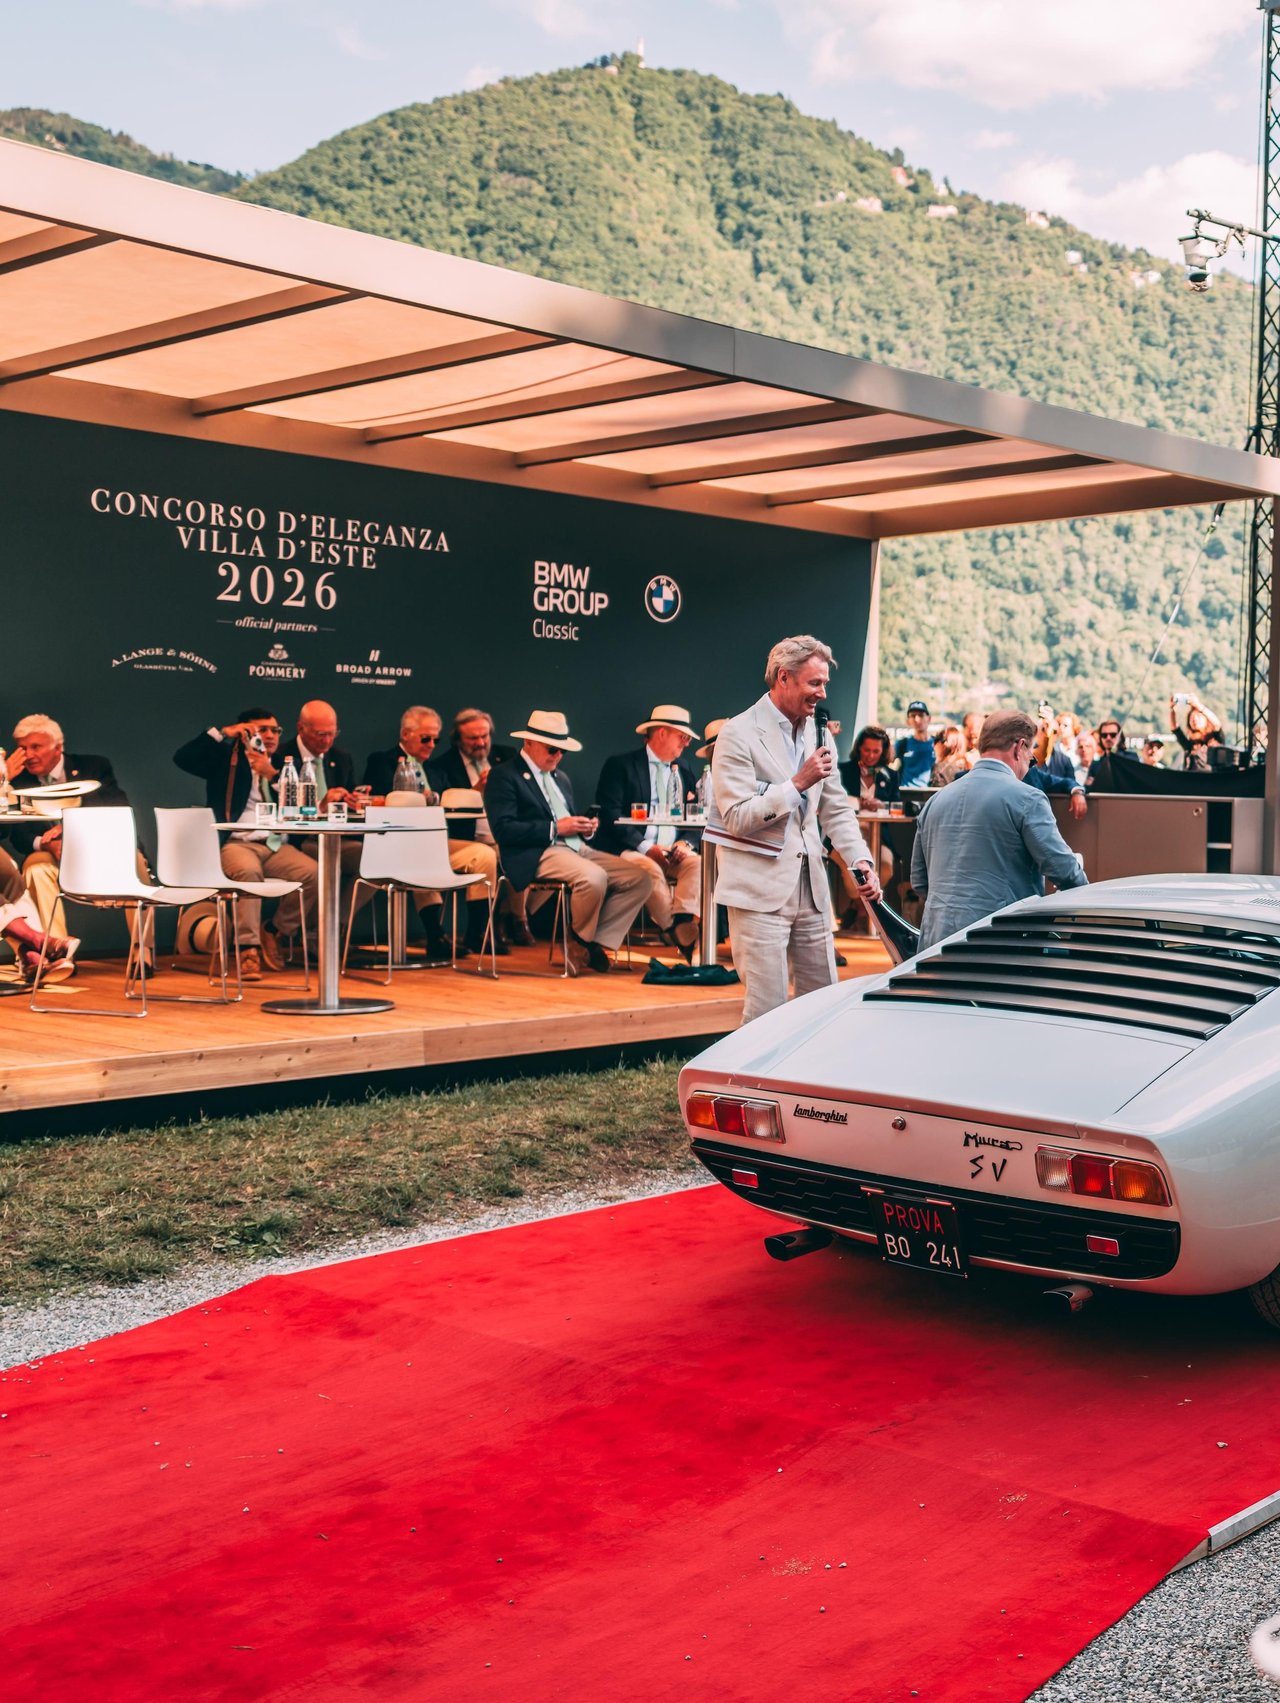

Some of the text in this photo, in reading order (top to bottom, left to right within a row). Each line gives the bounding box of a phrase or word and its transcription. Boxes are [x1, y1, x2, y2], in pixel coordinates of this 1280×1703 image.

[90, 488, 450, 552] CONCORSO D'ELEGANZA
[176, 525, 376, 569] VILLA D'ESTE
[216, 561, 337, 610] 2026
[534, 560, 590, 589] BMW
[533, 586, 609, 616] GROUP
[235, 616, 318, 633] official partners
[532, 618, 579, 641] Classic
[249, 665, 306, 679] POMMERY
[336, 664, 412, 677] BROAD ARROW
[793, 1104, 848, 1125] Lamborghini
[883, 1202, 945, 1235] PROVA
[926, 1242, 961, 1270] 241
